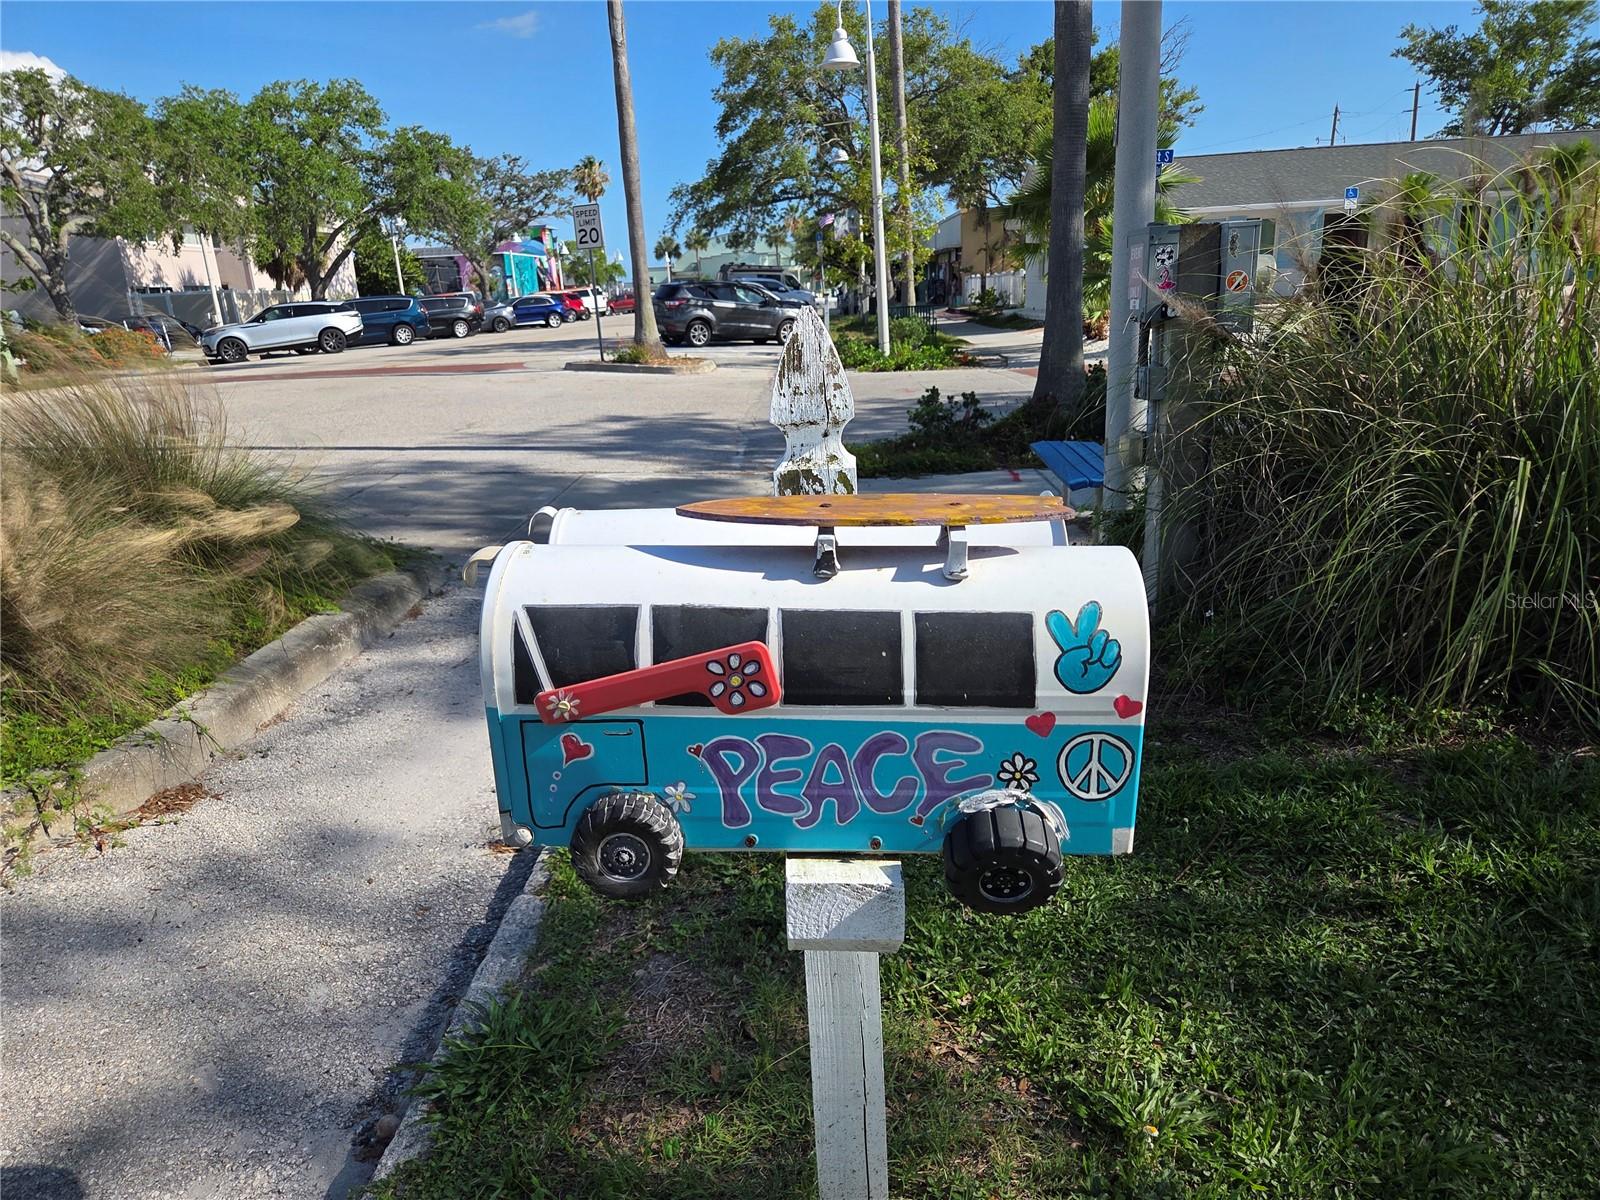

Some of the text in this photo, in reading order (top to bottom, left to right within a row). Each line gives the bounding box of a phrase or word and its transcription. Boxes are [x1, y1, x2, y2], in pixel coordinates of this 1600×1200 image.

[1164, 151, 1170, 162] S
[576, 209, 598, 218] SPEED
[578, 218, 596, 227] LIMIT
[578, 227, 600, 244] 20
[700, 730, 995, 830] PEACE
